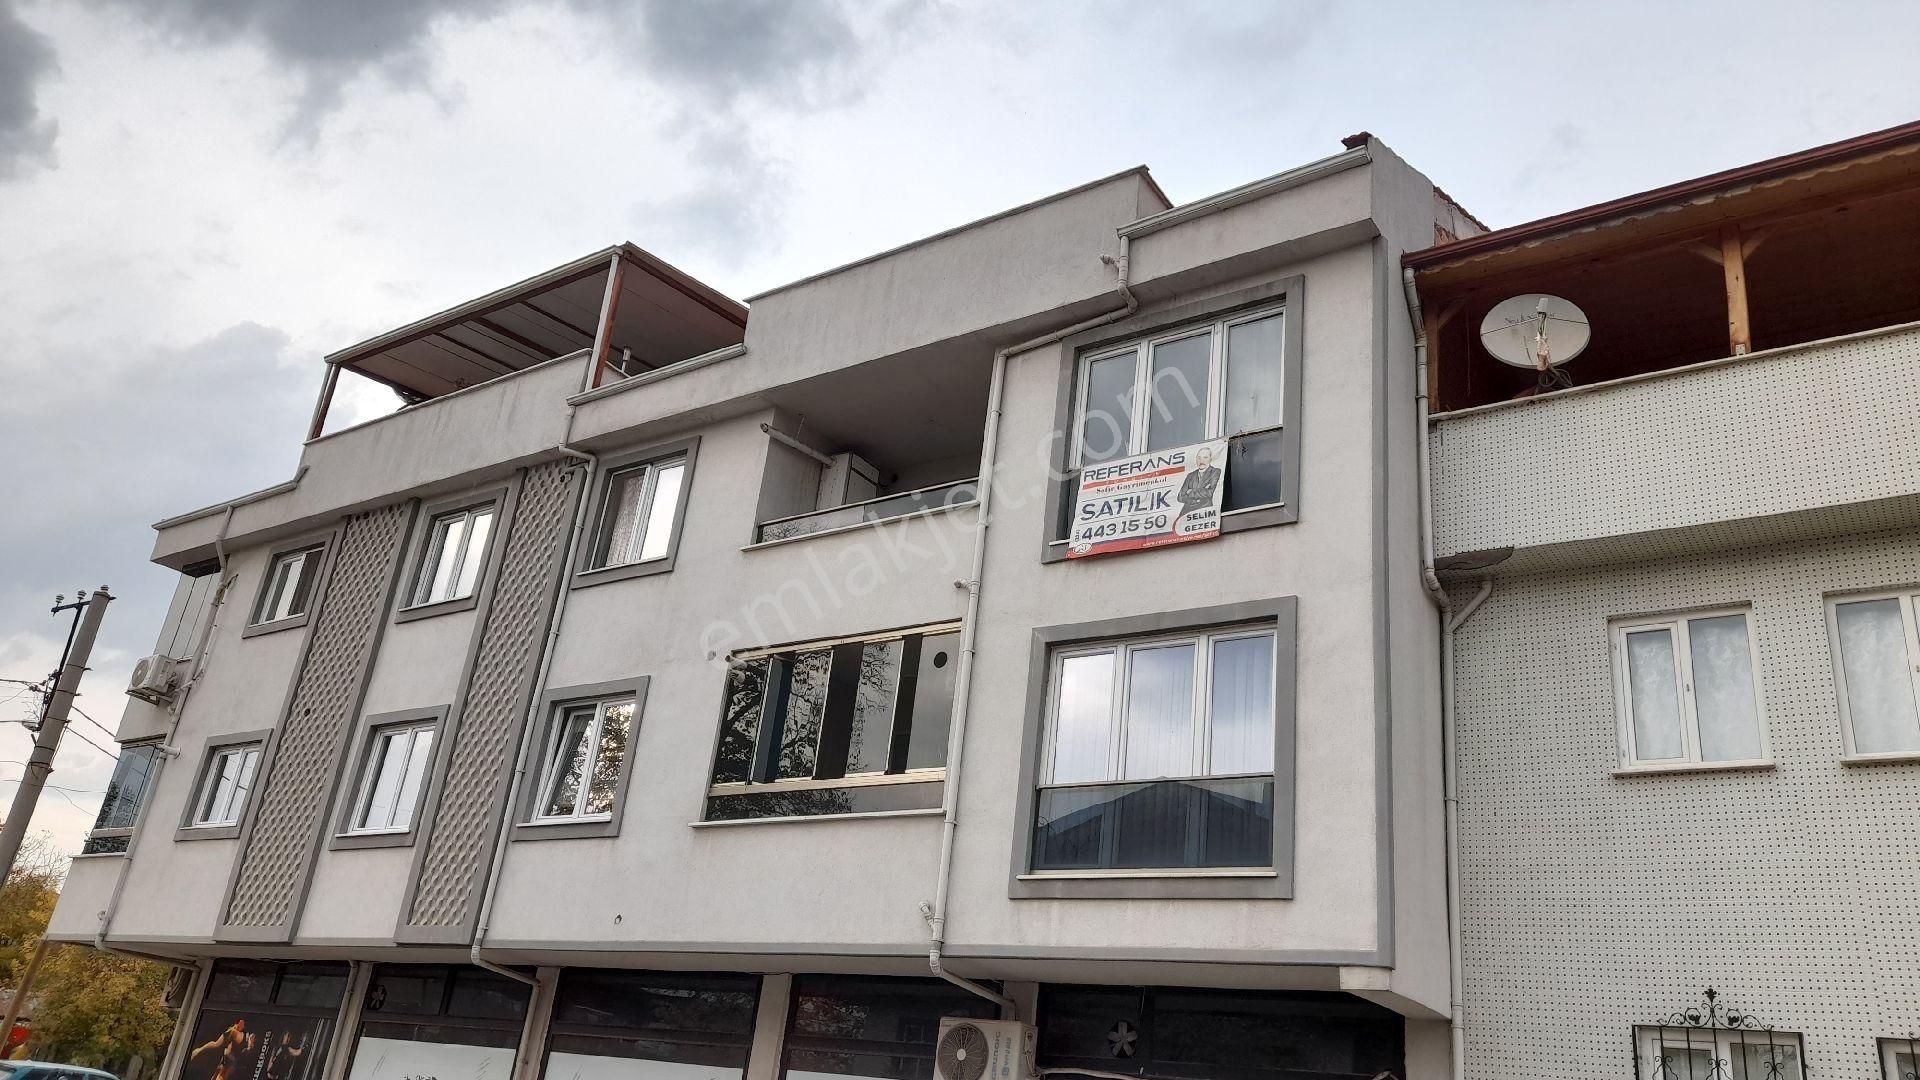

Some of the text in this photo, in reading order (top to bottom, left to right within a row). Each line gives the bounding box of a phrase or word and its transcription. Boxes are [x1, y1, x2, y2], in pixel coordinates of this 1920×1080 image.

[1083, 451, 1186, 482] REFERANS
[1080, 489, 1173, 521] SATILIK
[1186, 509, 1217, 522] SELİM
[1081, 523, 1117, 541] 443
[1121, 519, 1140, 533] 15
[1144, 514, 1168, 530] 50
[1184, 521, 1217, 533] GEZER
